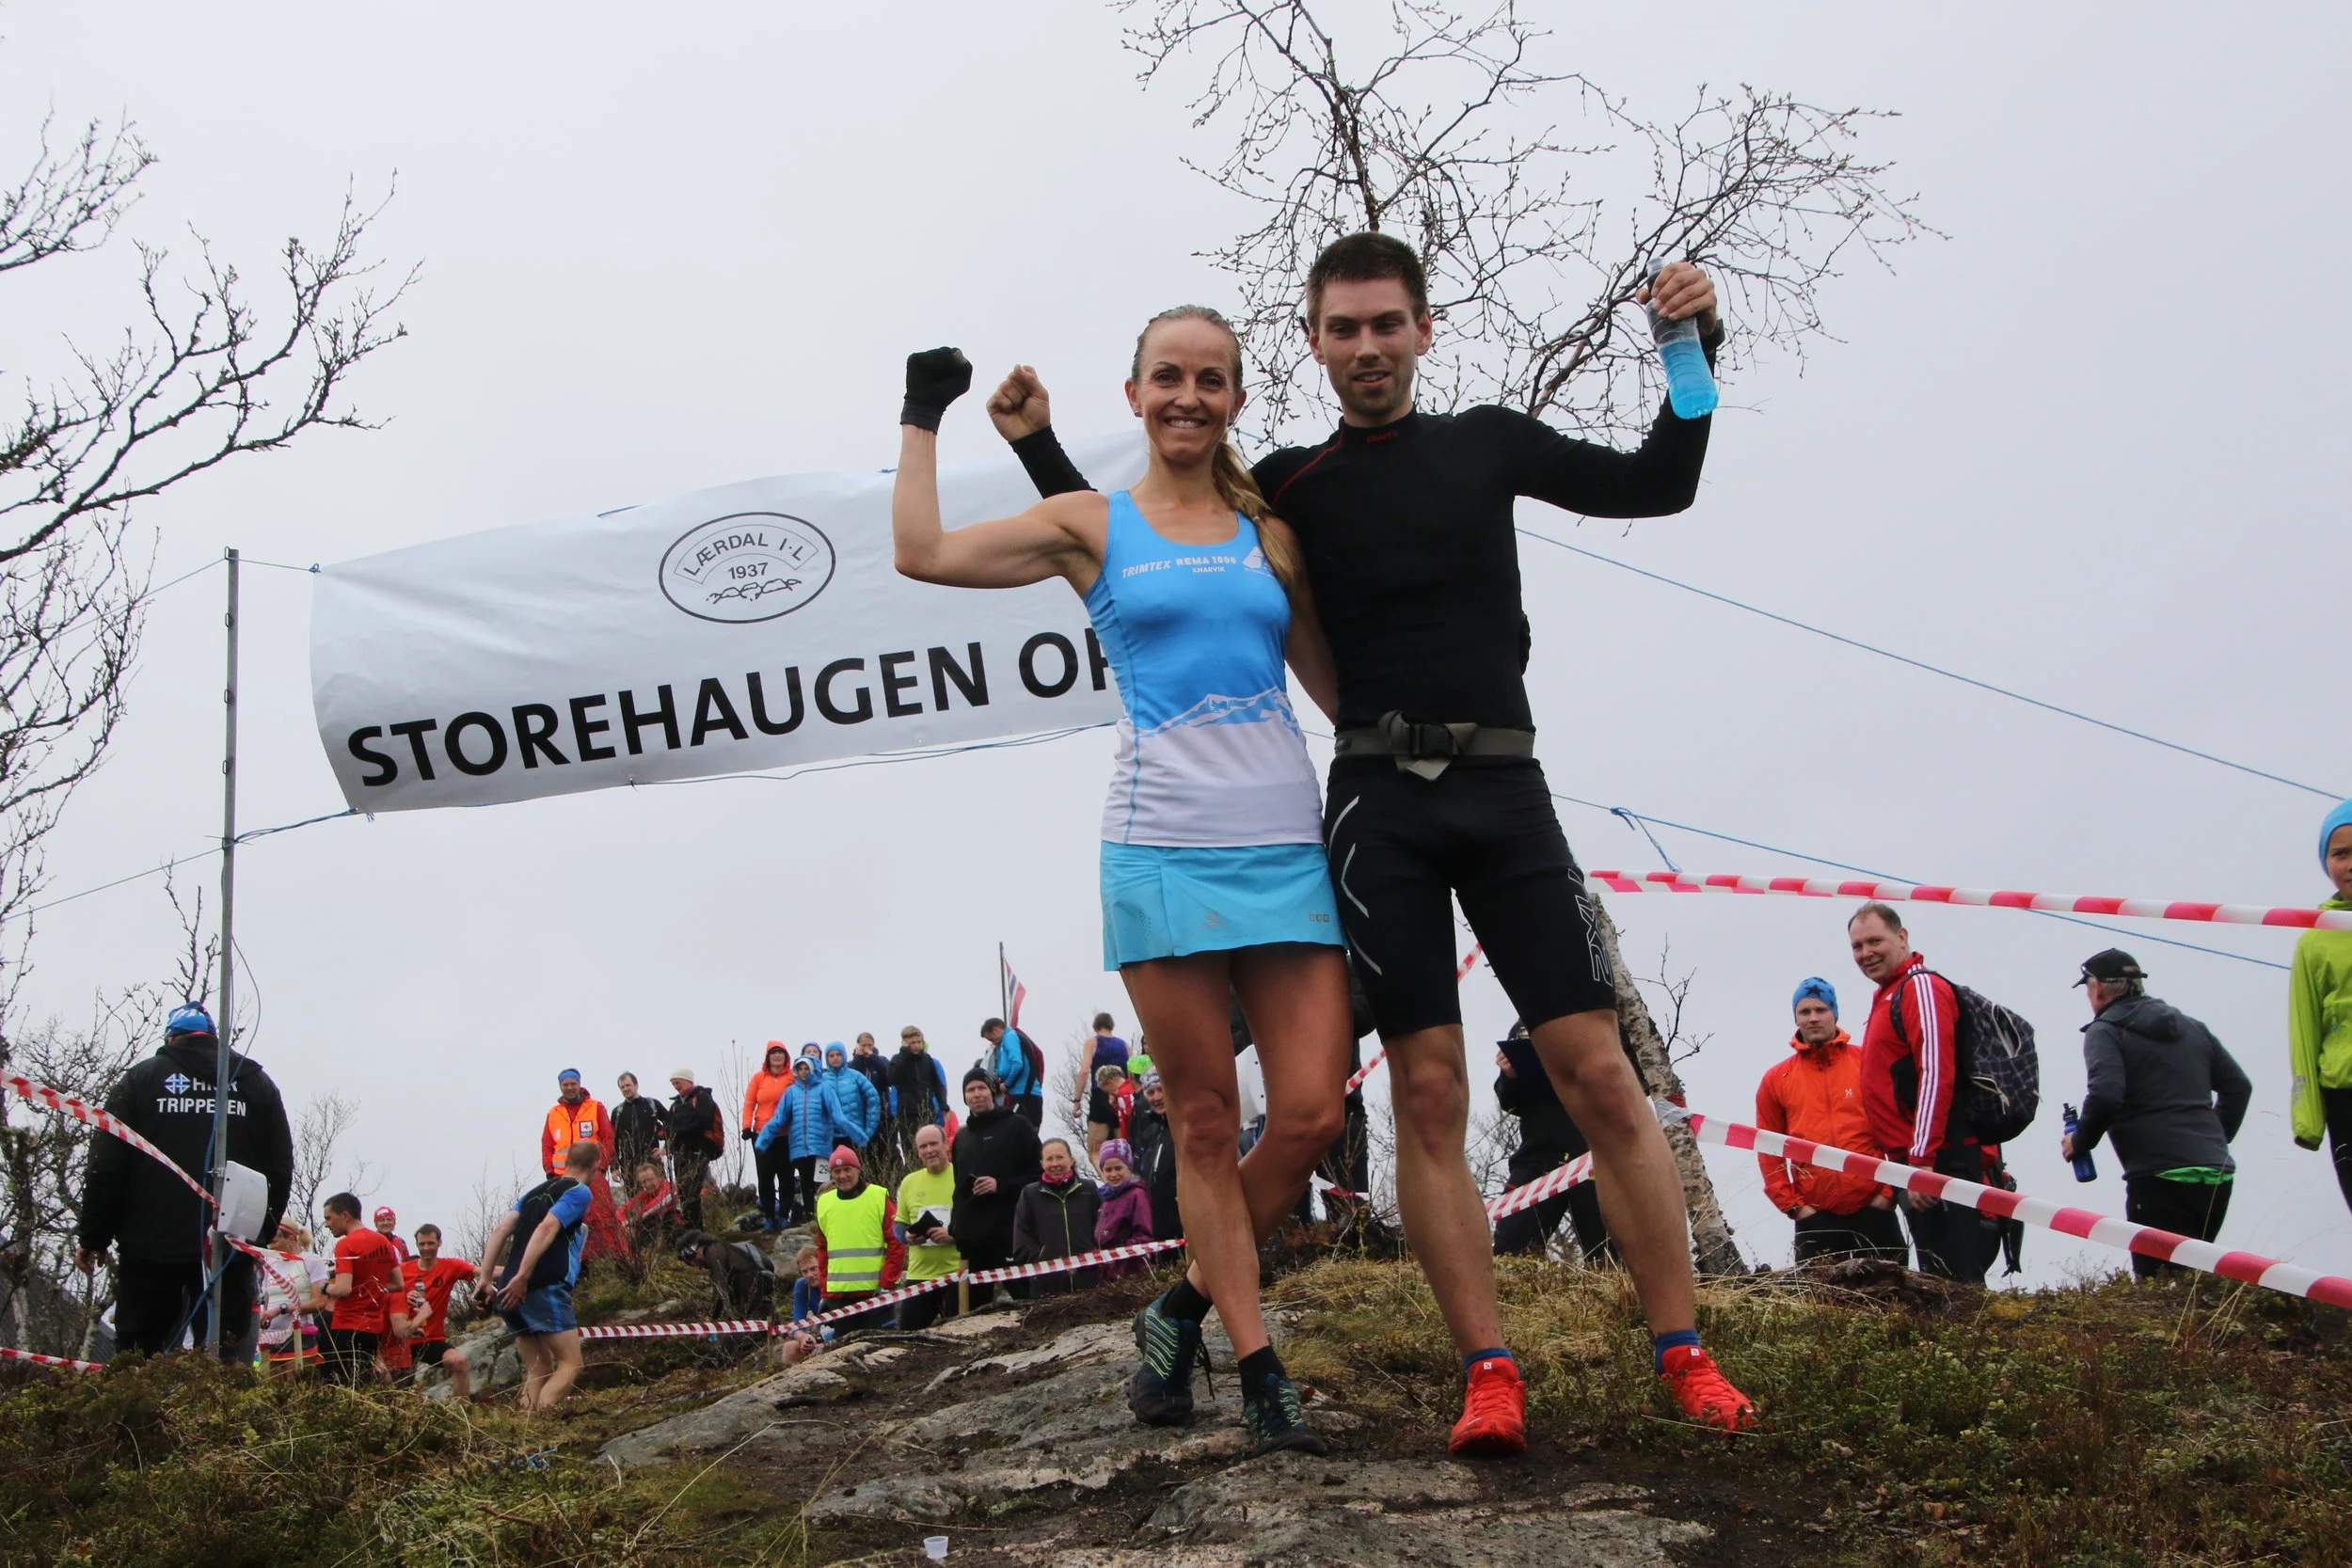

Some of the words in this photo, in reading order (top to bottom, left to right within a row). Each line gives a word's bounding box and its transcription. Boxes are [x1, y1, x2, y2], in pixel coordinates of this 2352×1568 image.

[683, 532, 769, 576] LÆRDAL
[727, 562, 769, 579] 1937
[1121, 561, 1171, 578] TRIMTEX
[1175, 557, 1209, 566] REMA
[1211, 555, 1237, 564] 1000
[348, 641, 990, 785] STOREHAUGEN
[156, 1098, 246, 1117] TRIPPEEN
